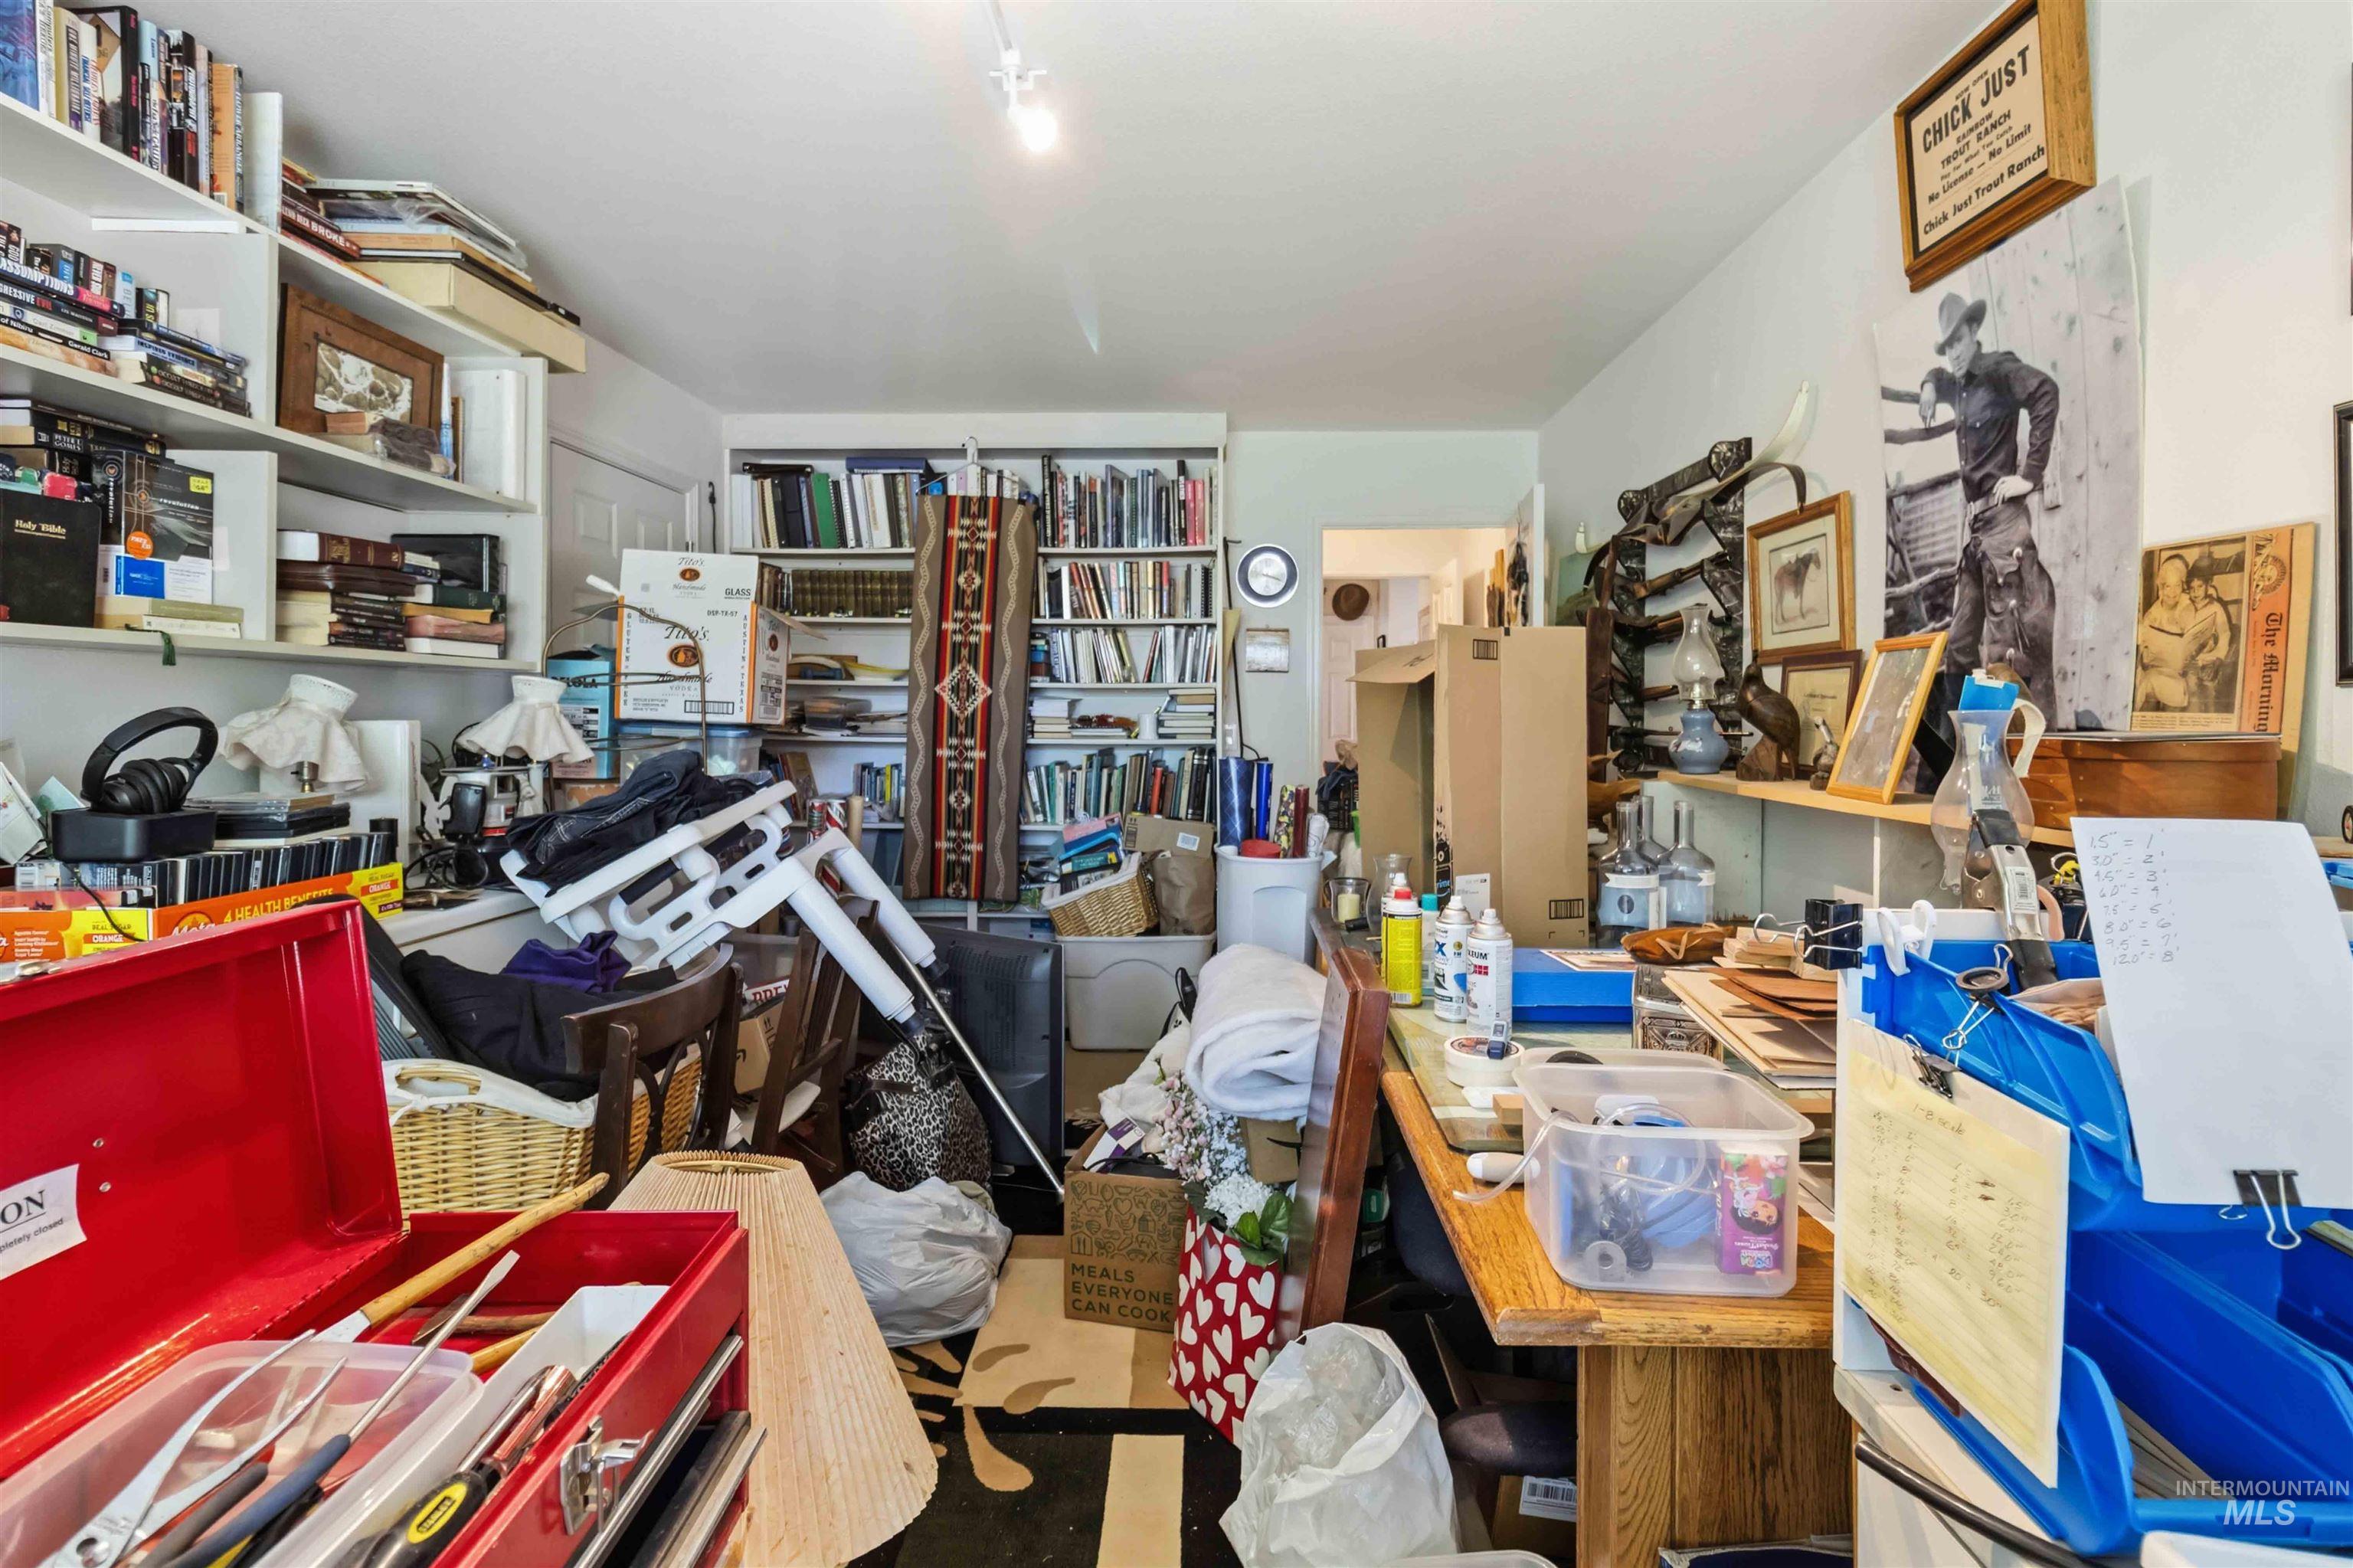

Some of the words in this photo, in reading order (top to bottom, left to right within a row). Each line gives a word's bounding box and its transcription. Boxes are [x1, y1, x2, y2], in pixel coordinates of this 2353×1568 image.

[1923, 93, 1973, 154] CHICK
[1981, 44, 2030, 108] JUST
[1941, 140, 1972, 169] TROUT
[1976, 110, 2011, 143] RANCH
[1956, 110, 1995, 144] RAINBOW
[1928, 191, 1940, 205] No
[1942, 167, 1974, 194] License
[1988, 146, 2002, 162] No
[2006, 123, 2031, 149] Limit
[1923, 211, 1949, 235] Chick
[1953, 194, 1973, 217] Just
[1975, 173, 2004, 201] Trout
[2008, 144, 2045, 179] Ranch
[311, 222, 345, 247] BROKE
[1, 316, 8, 325] of
[68, 340, 91, 353] Gerald
[91, 346, 110, 360] Clark
[15, 519, 37, 531] Holy
[40, 523, 67, 535] Bible
[725, 588, 751, 597] GLASS
[2260, 611, 2283, 647] The
[2253, 653, 2280, 732] Morning
[224, 910, 234, 924] 4
[234, 899, 282, 921] HEALTH
[93, 935, 124, 943] ORANGE
[34, 1217, 64, 1236] closed
[1072, 1263, 1135, 1283] MEALS
[1072, 1282, 1173, 1305] EVERYONE
[1072, 1298, 1111, 1317] CAN
[1118, 1305, 1170, 1323] COOK
